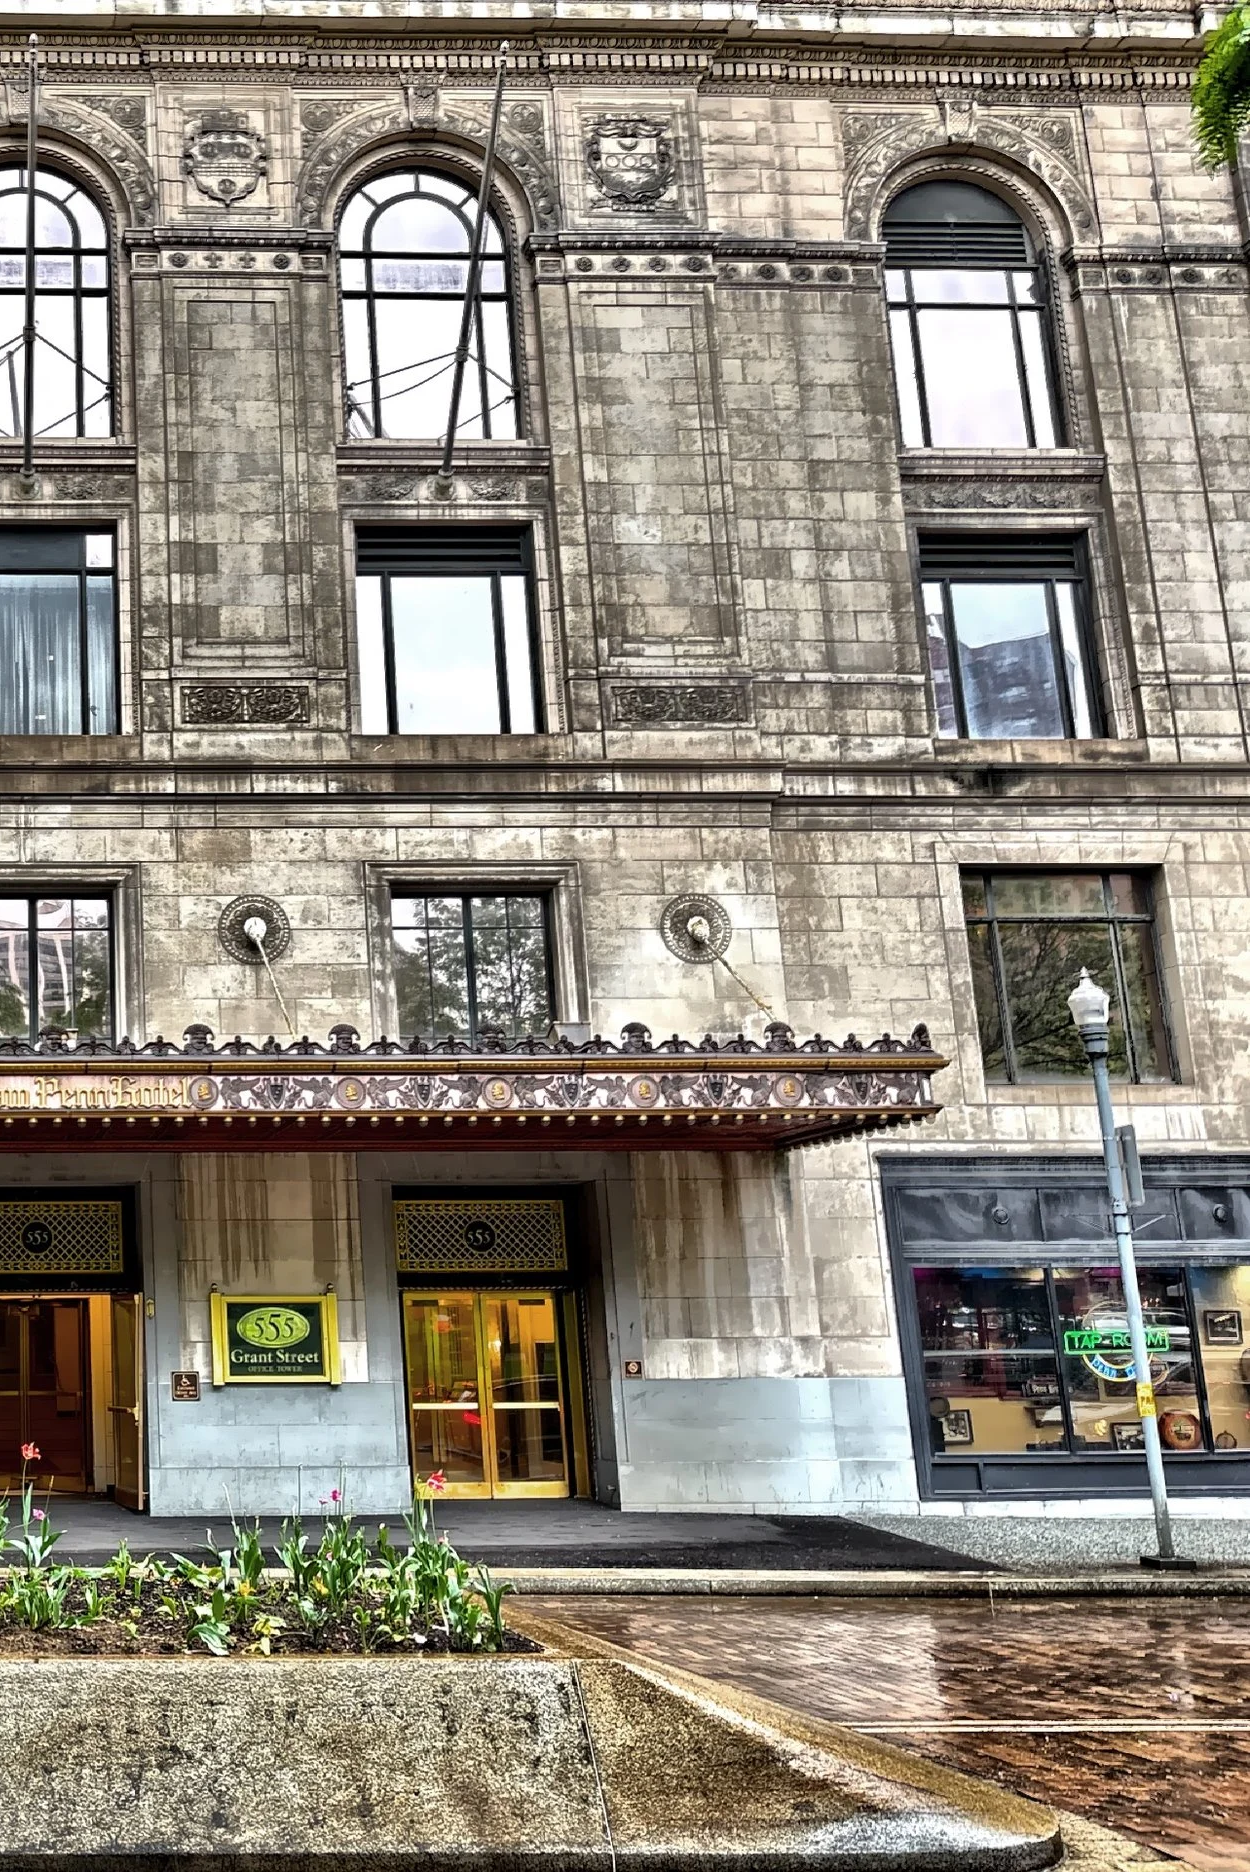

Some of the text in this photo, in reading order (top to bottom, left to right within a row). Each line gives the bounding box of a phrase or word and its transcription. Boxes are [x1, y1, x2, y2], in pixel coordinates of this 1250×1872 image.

[33, 1076, 110, 1108] Penn
[110, 1076, 191, 1108] Hotel
[26, 1230, 49, 1245] 555
[467, 1230, 491, 1245] 555
[252, 1313, 295, 1342] 555
[1112, 1333, 1163, 1348] ROM
[230, 1348, 319, 1363] Grant Street
